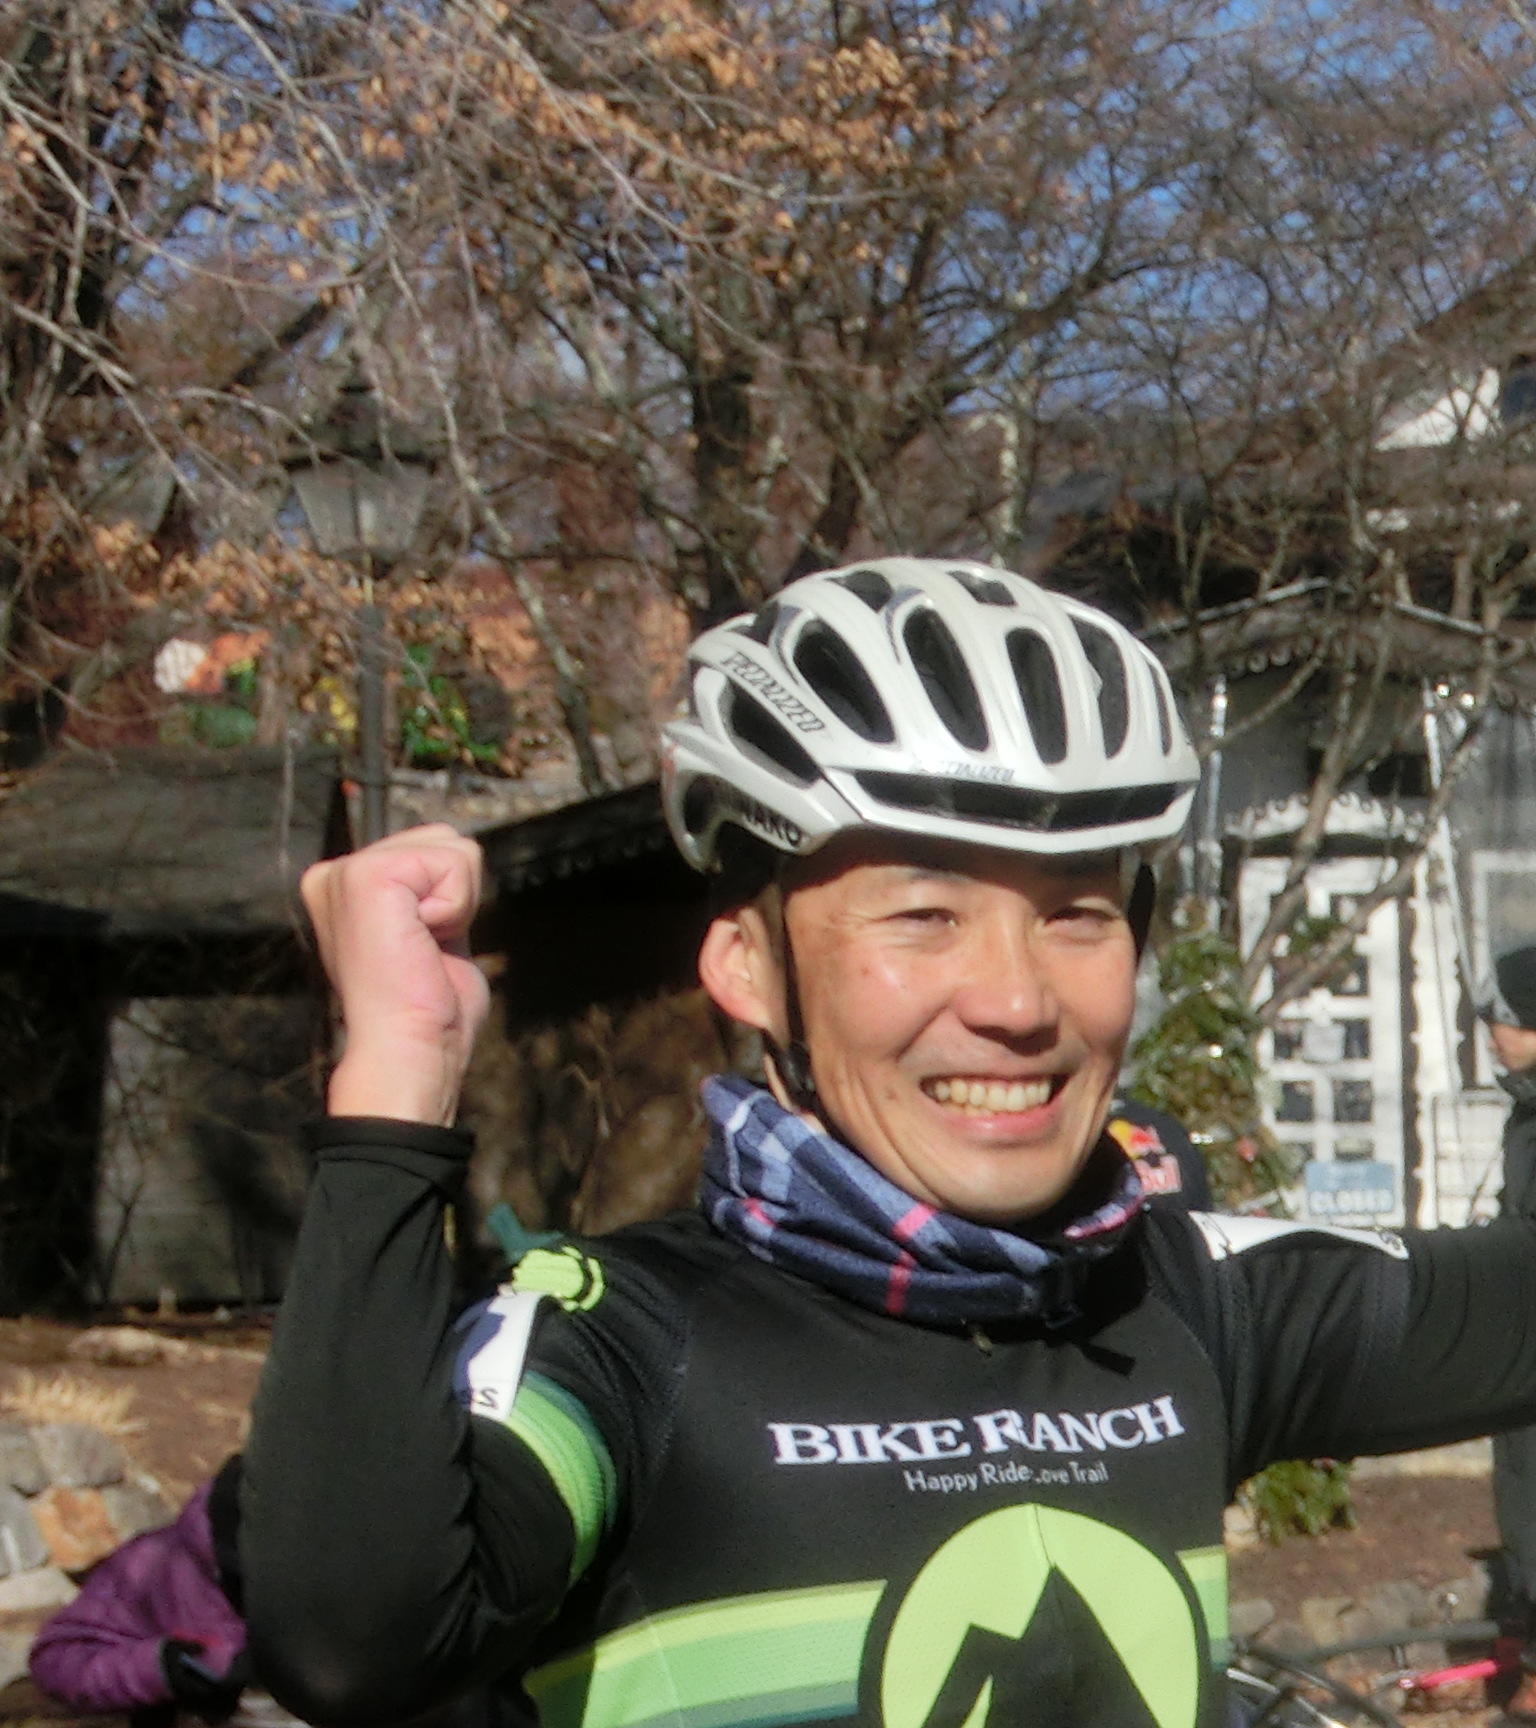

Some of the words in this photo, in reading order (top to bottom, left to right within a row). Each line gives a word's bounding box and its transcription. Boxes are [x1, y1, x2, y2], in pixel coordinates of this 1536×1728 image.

[768, 1418, 971, 1465] BIKE
[973, 1395, 1185, 1454] RANCH
[903, 1469, 978, 1493] Happy
[979, 1461, 1030, 1485] Ride
[1034, 1467, 1070, 1484] ove
[1068, 1461, 1109, 1484] Trail
